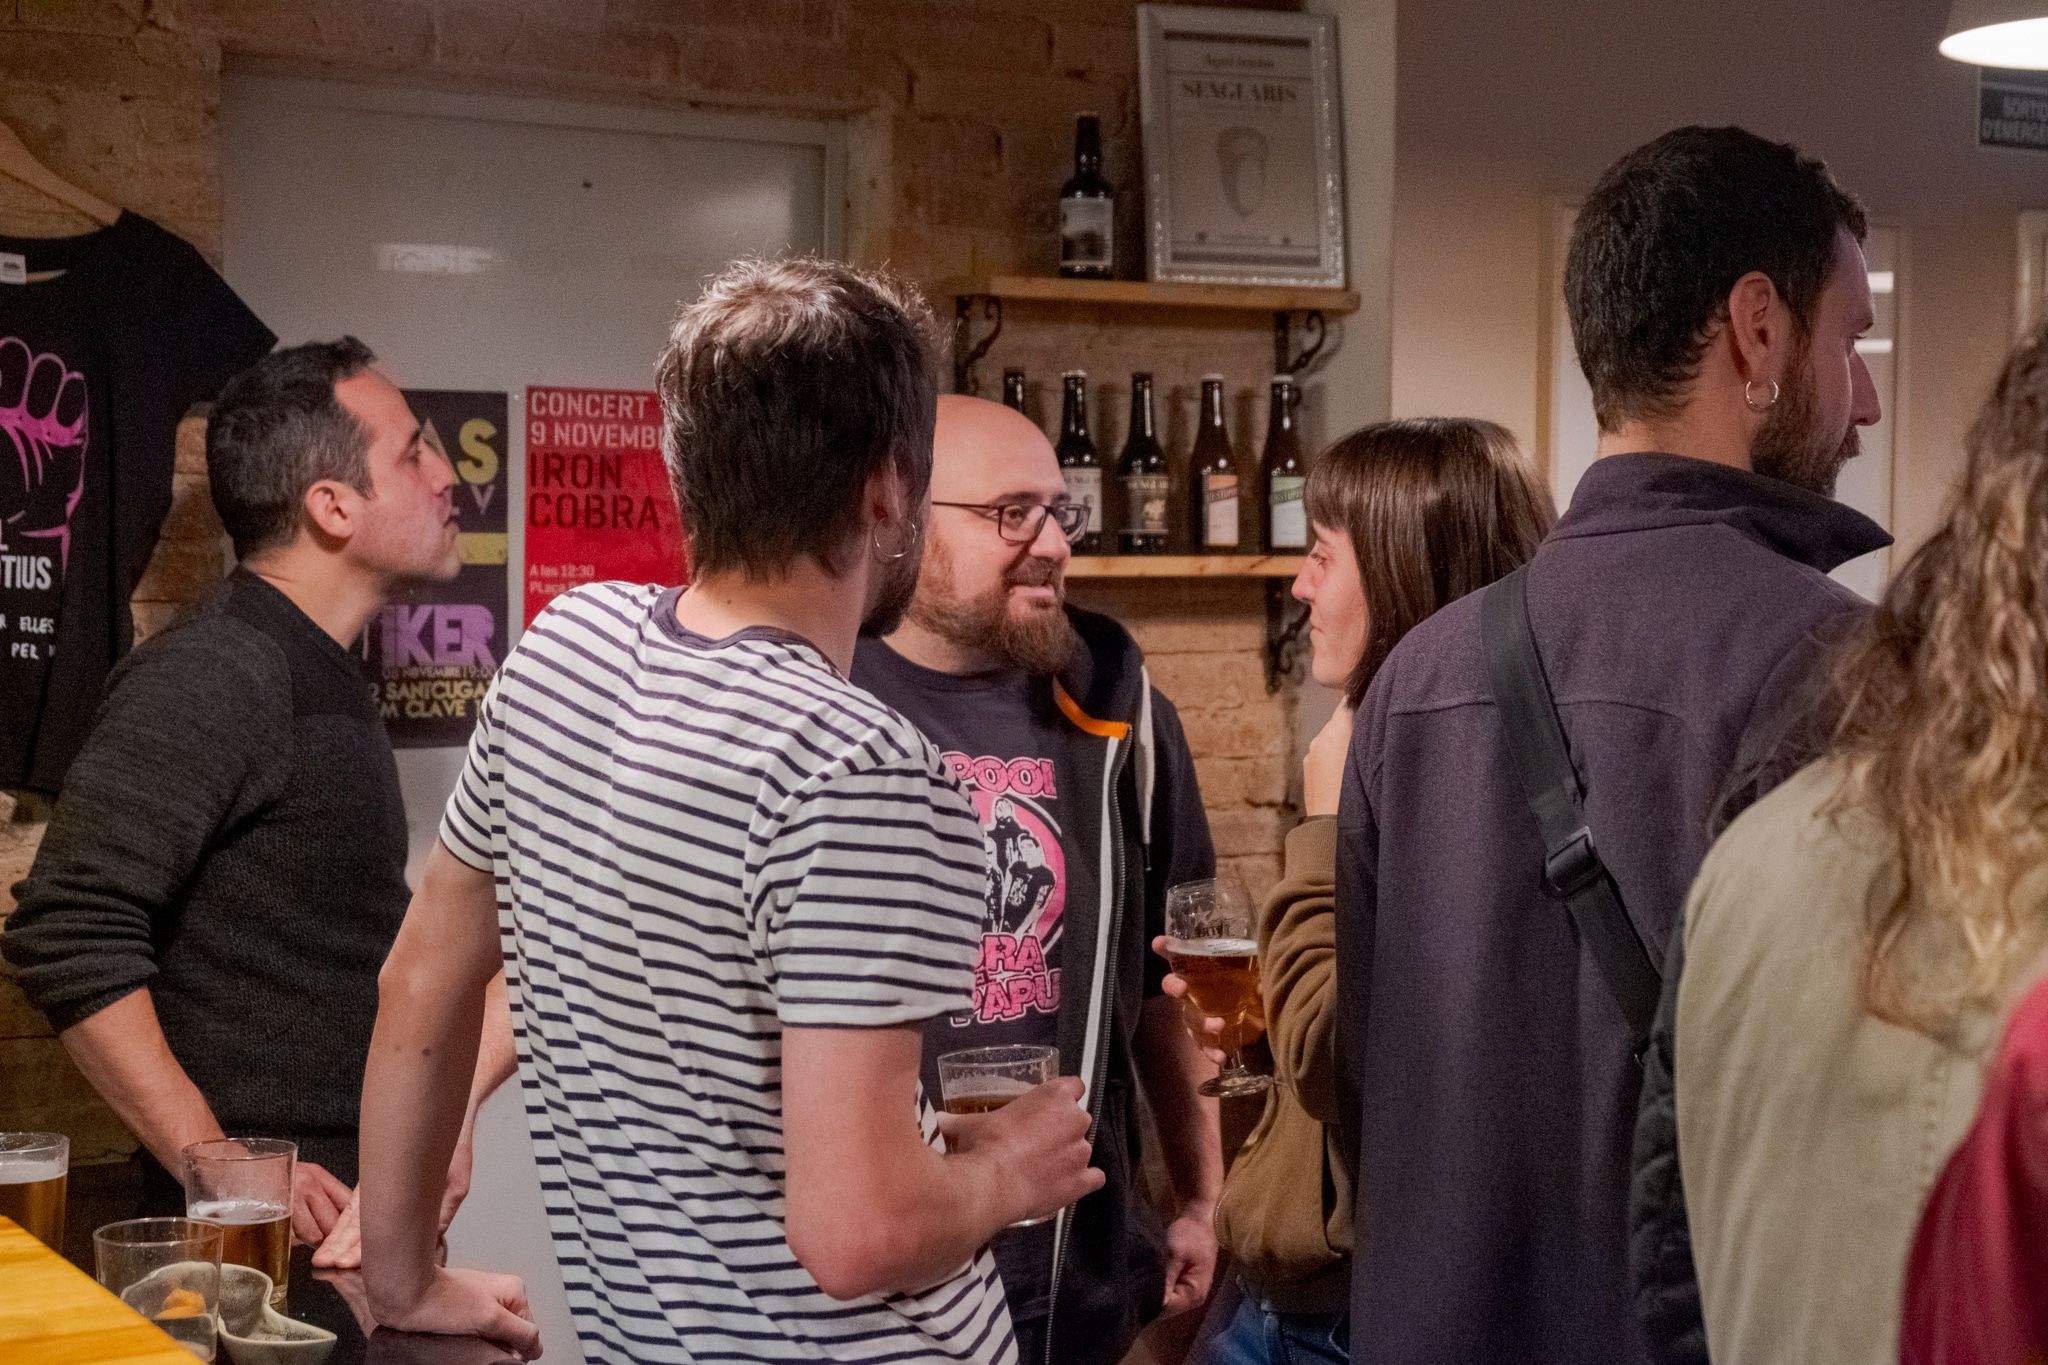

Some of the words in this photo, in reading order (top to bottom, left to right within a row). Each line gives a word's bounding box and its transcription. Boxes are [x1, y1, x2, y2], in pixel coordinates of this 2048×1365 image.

[530, 390, 650, 418] CONCERT
[531, 420, 547, 446] 9
[553, 421, 664, 449] NOVEMB
[529, 453, 623, 489] IRON
[529, 492, 661, 529] COBRA
[0, 554, 52, 591] TIUS
[19, 615, 55, 635] ELLES
